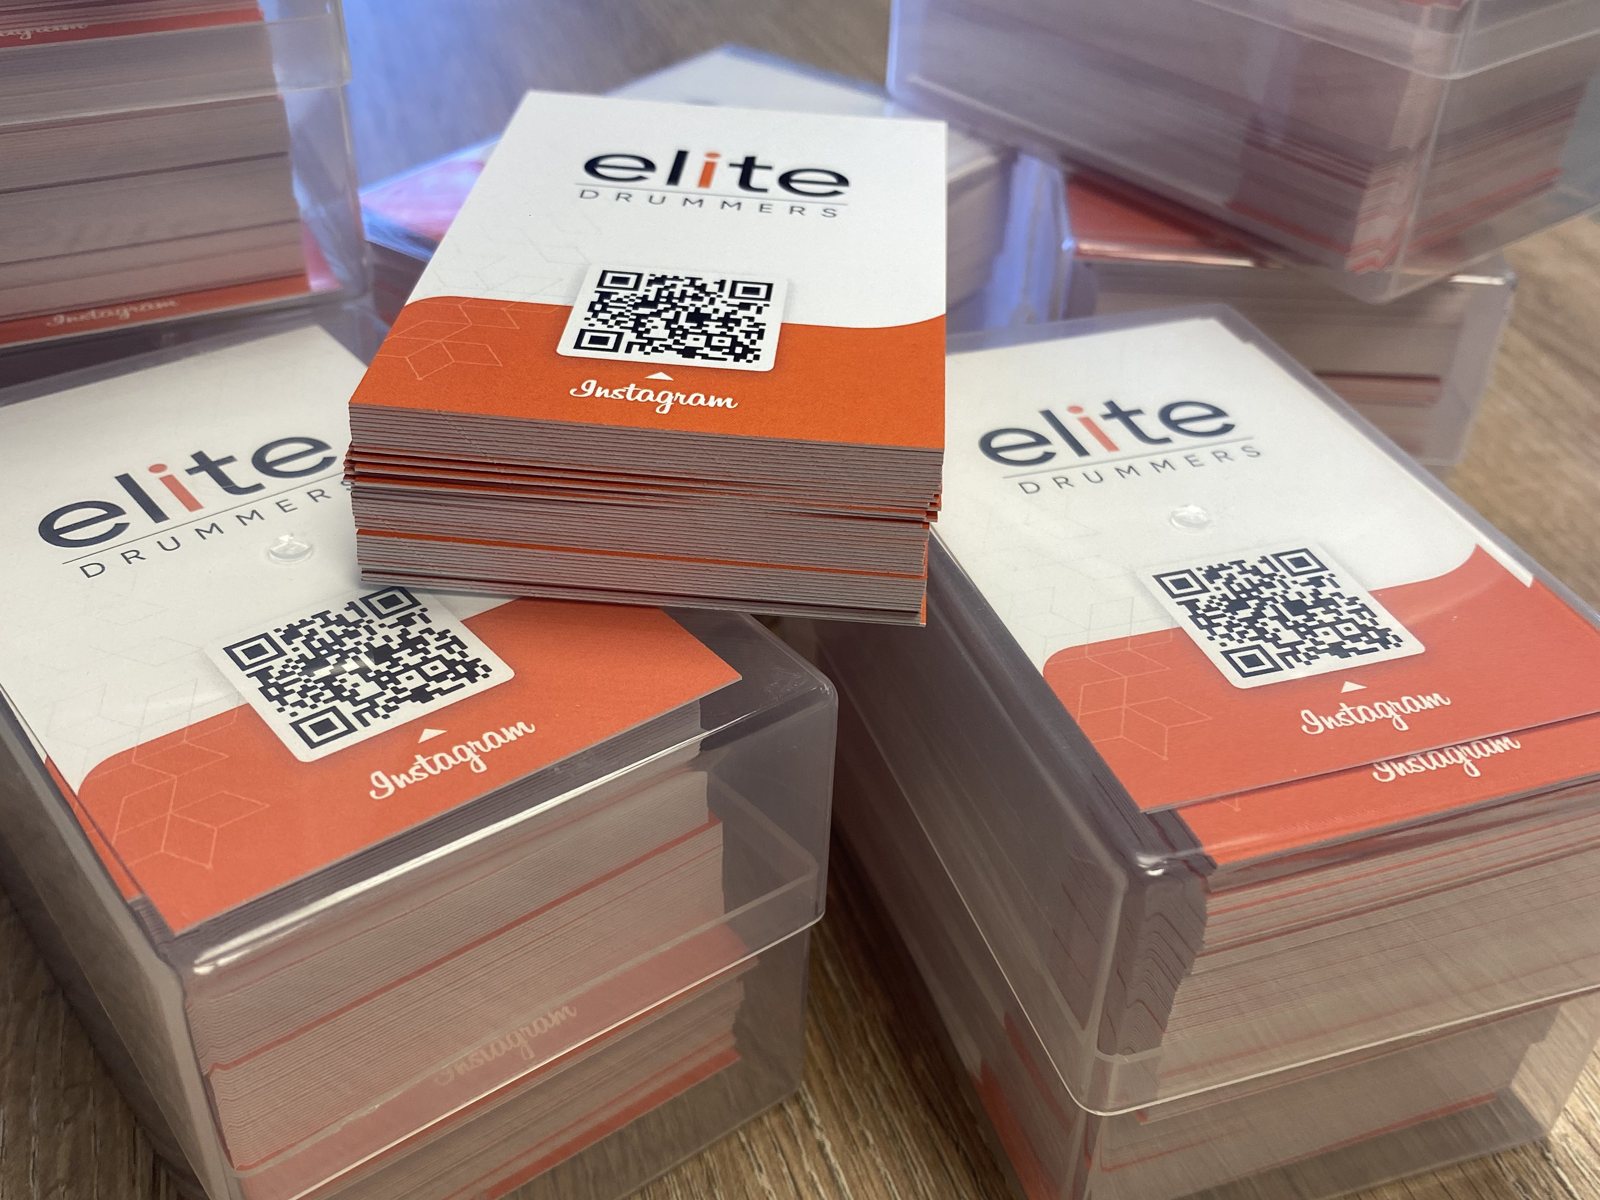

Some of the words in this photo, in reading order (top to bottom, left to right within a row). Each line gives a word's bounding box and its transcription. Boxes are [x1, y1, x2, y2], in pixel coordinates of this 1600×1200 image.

[584, 149, 850, 197] elite
[579, 189, 838, 218] DRUMMERS
[569, 379, 738, 414] Instagram
[978, 400, 1236, 467] elite
[38, 436, 338, 548] elite
[1017, 445, 1262, 495] DRUMMERS
[1300, 692, 1452, 735] Instagram
[369, 719, 536, 800] Instagram
